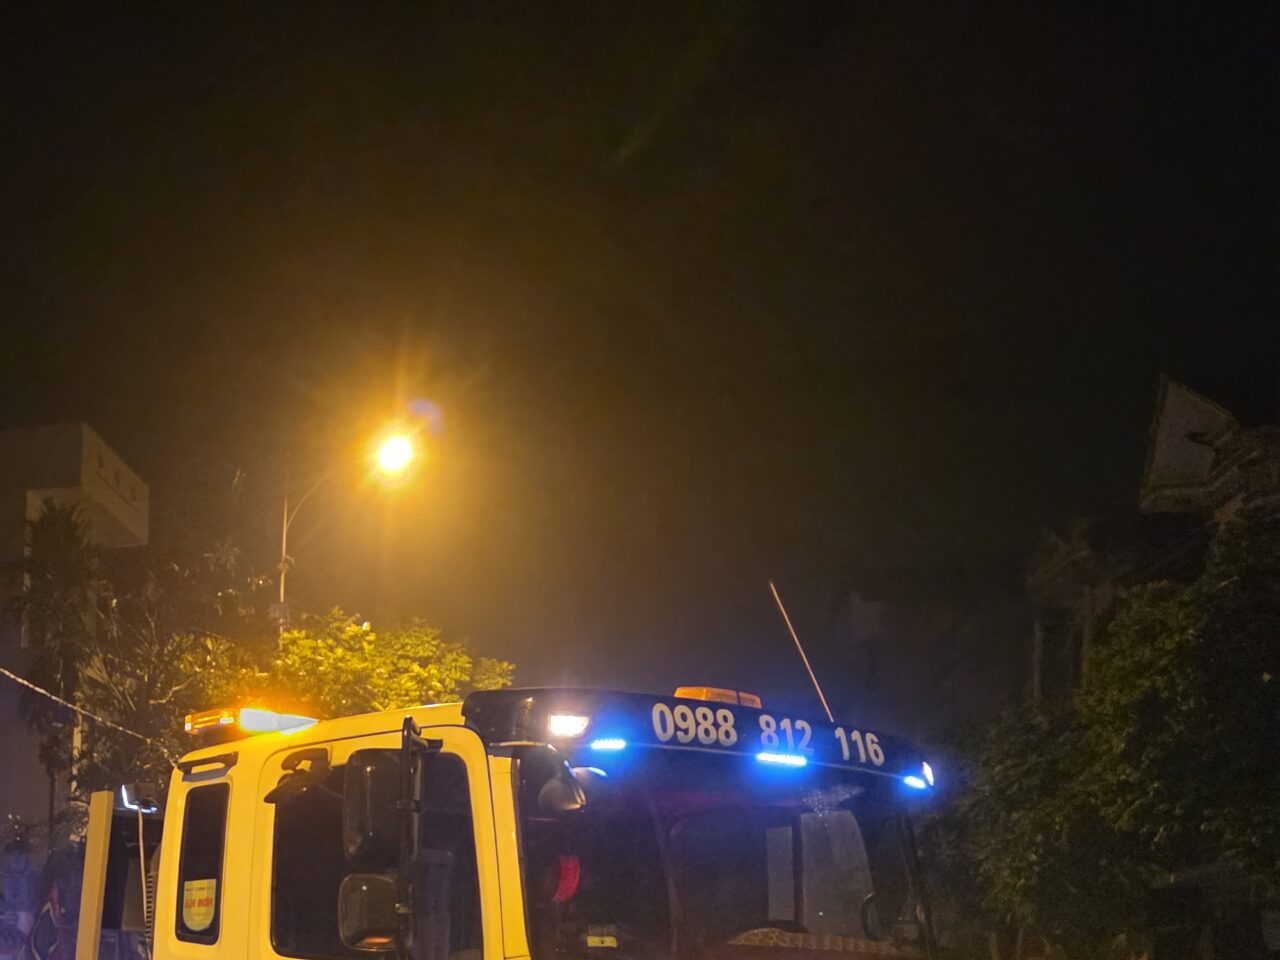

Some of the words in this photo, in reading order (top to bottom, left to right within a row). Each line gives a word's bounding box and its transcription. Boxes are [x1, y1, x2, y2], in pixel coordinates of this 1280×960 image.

[652, 703, 737, 746] 0988
[759, 714, 815, 755] 812
[835, 727, 885, 766] 116
